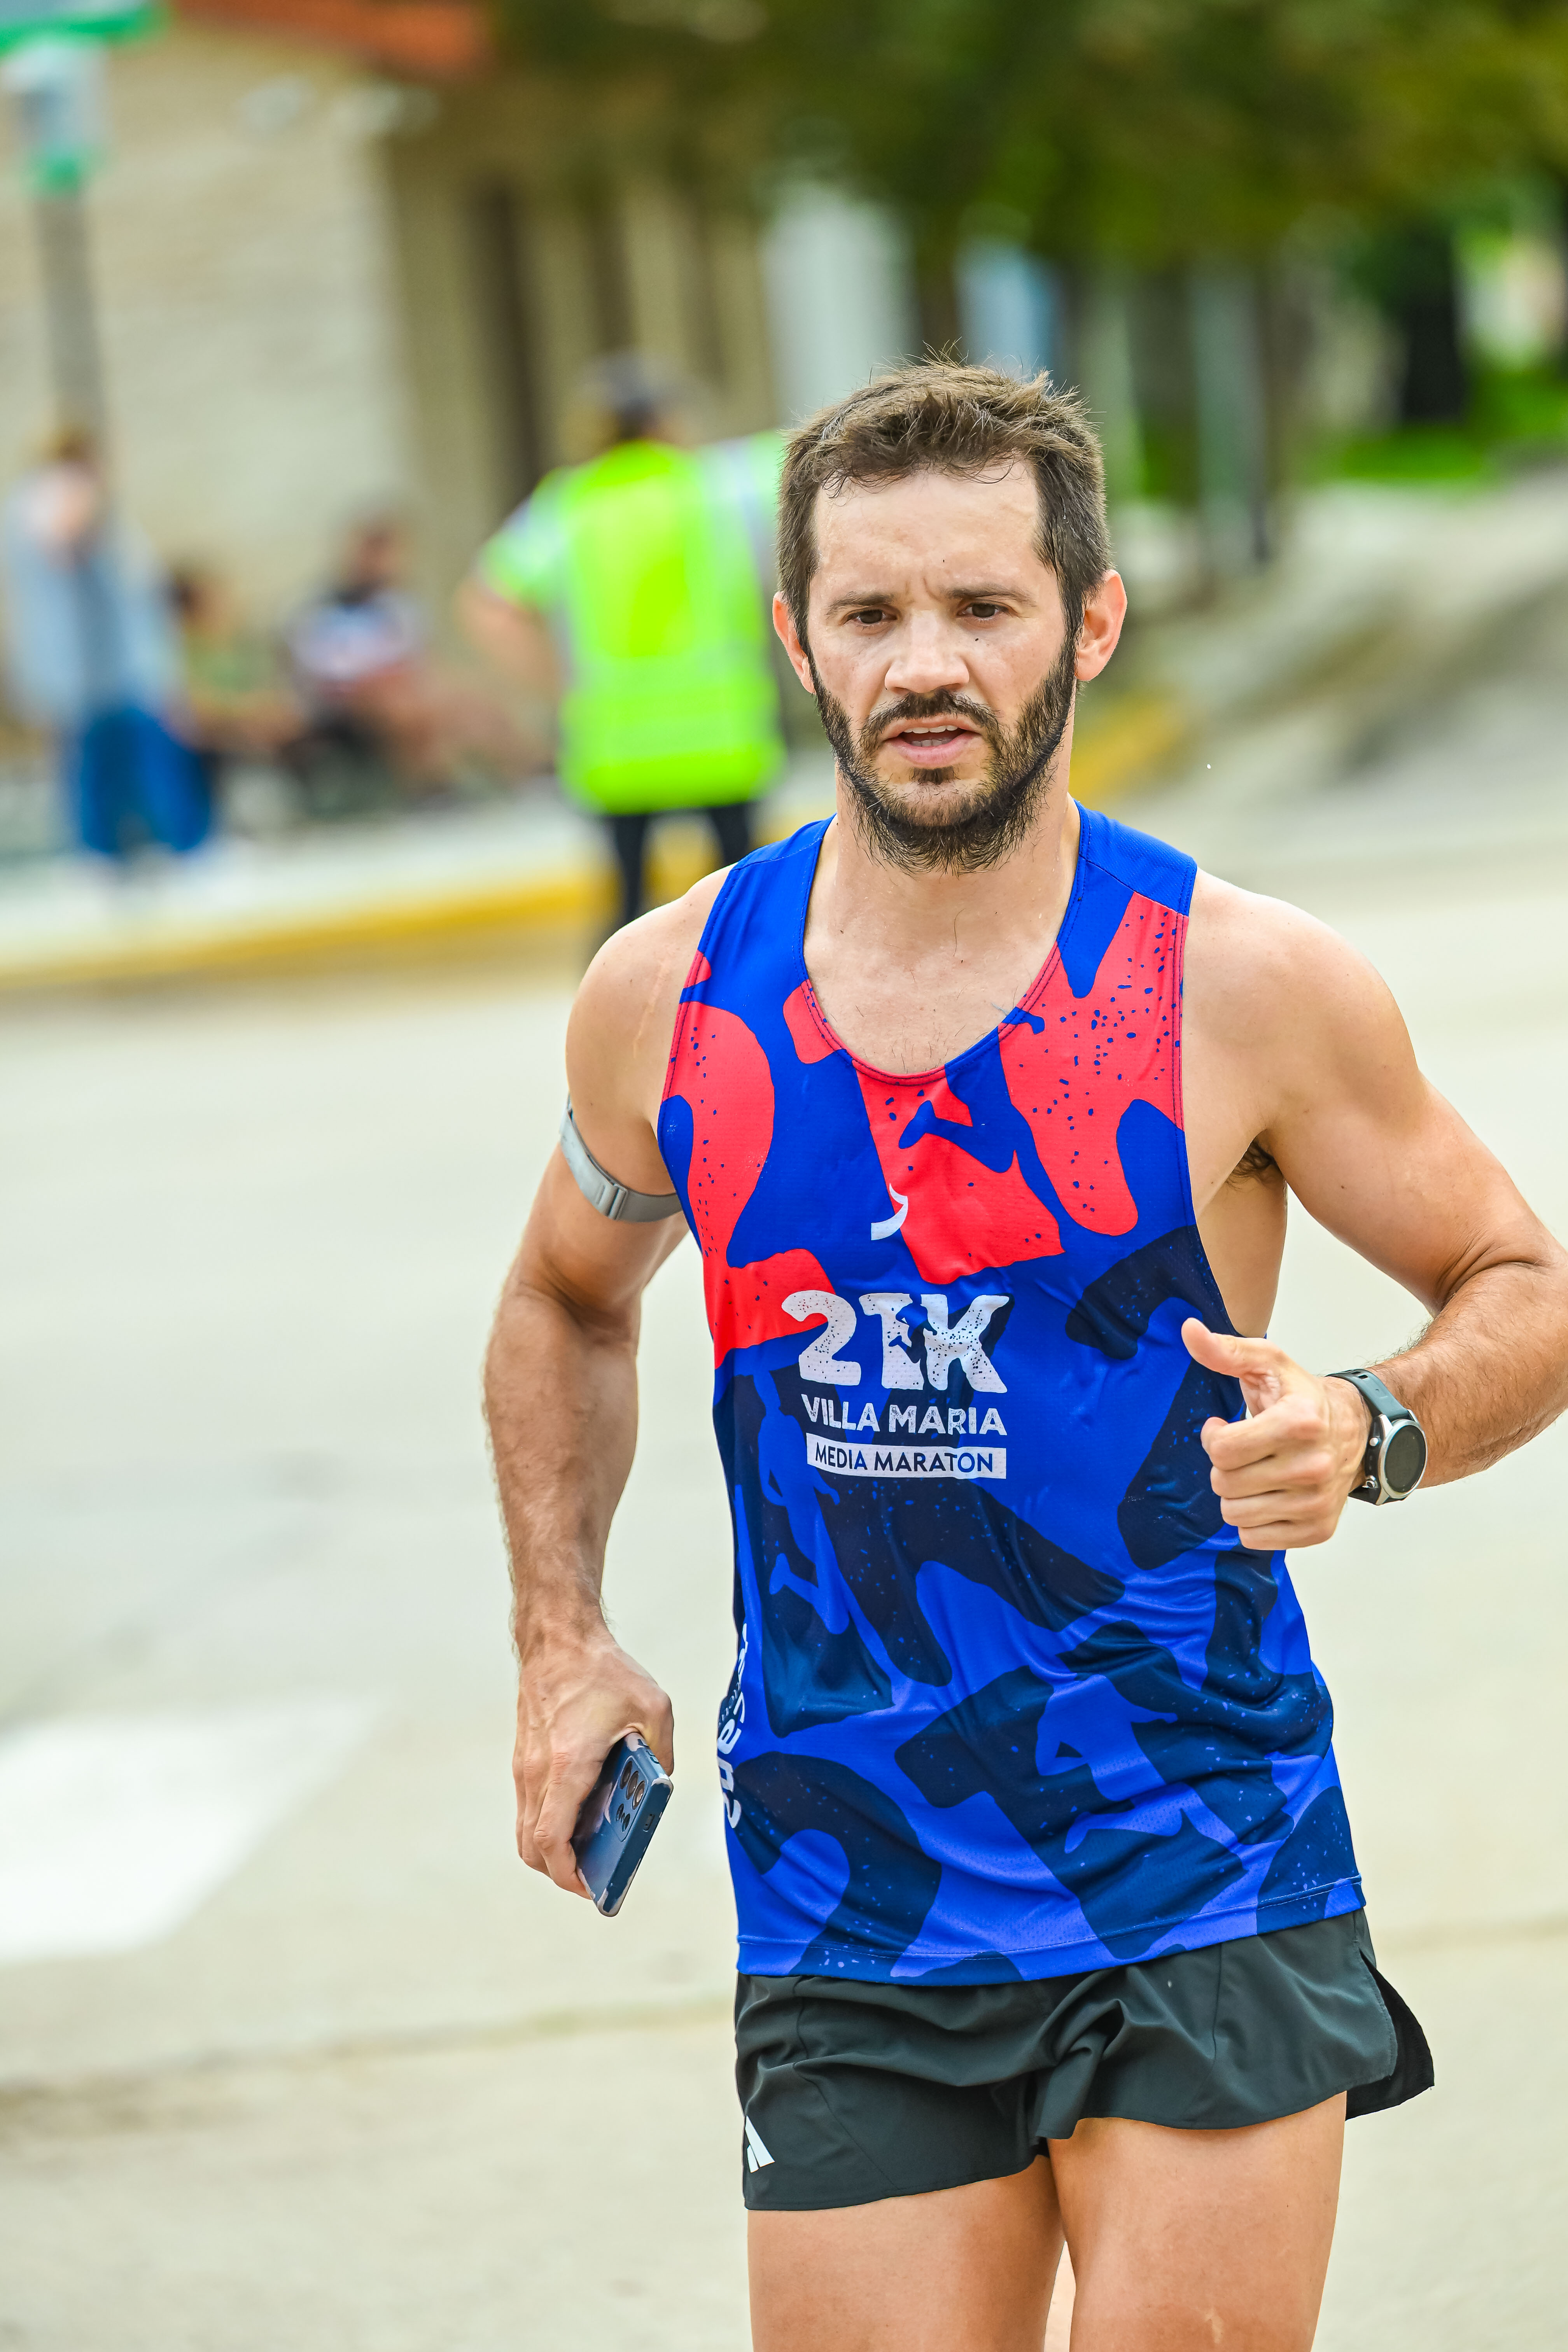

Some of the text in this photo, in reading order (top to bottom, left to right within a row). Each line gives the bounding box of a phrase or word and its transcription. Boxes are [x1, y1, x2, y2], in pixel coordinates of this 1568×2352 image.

[781, 1290, 1010, 1393] 21K
[801, 1394, 1008, 1436] VILLA MARIA
[815, 1442, 994, 1473] MEDIA MARATON
